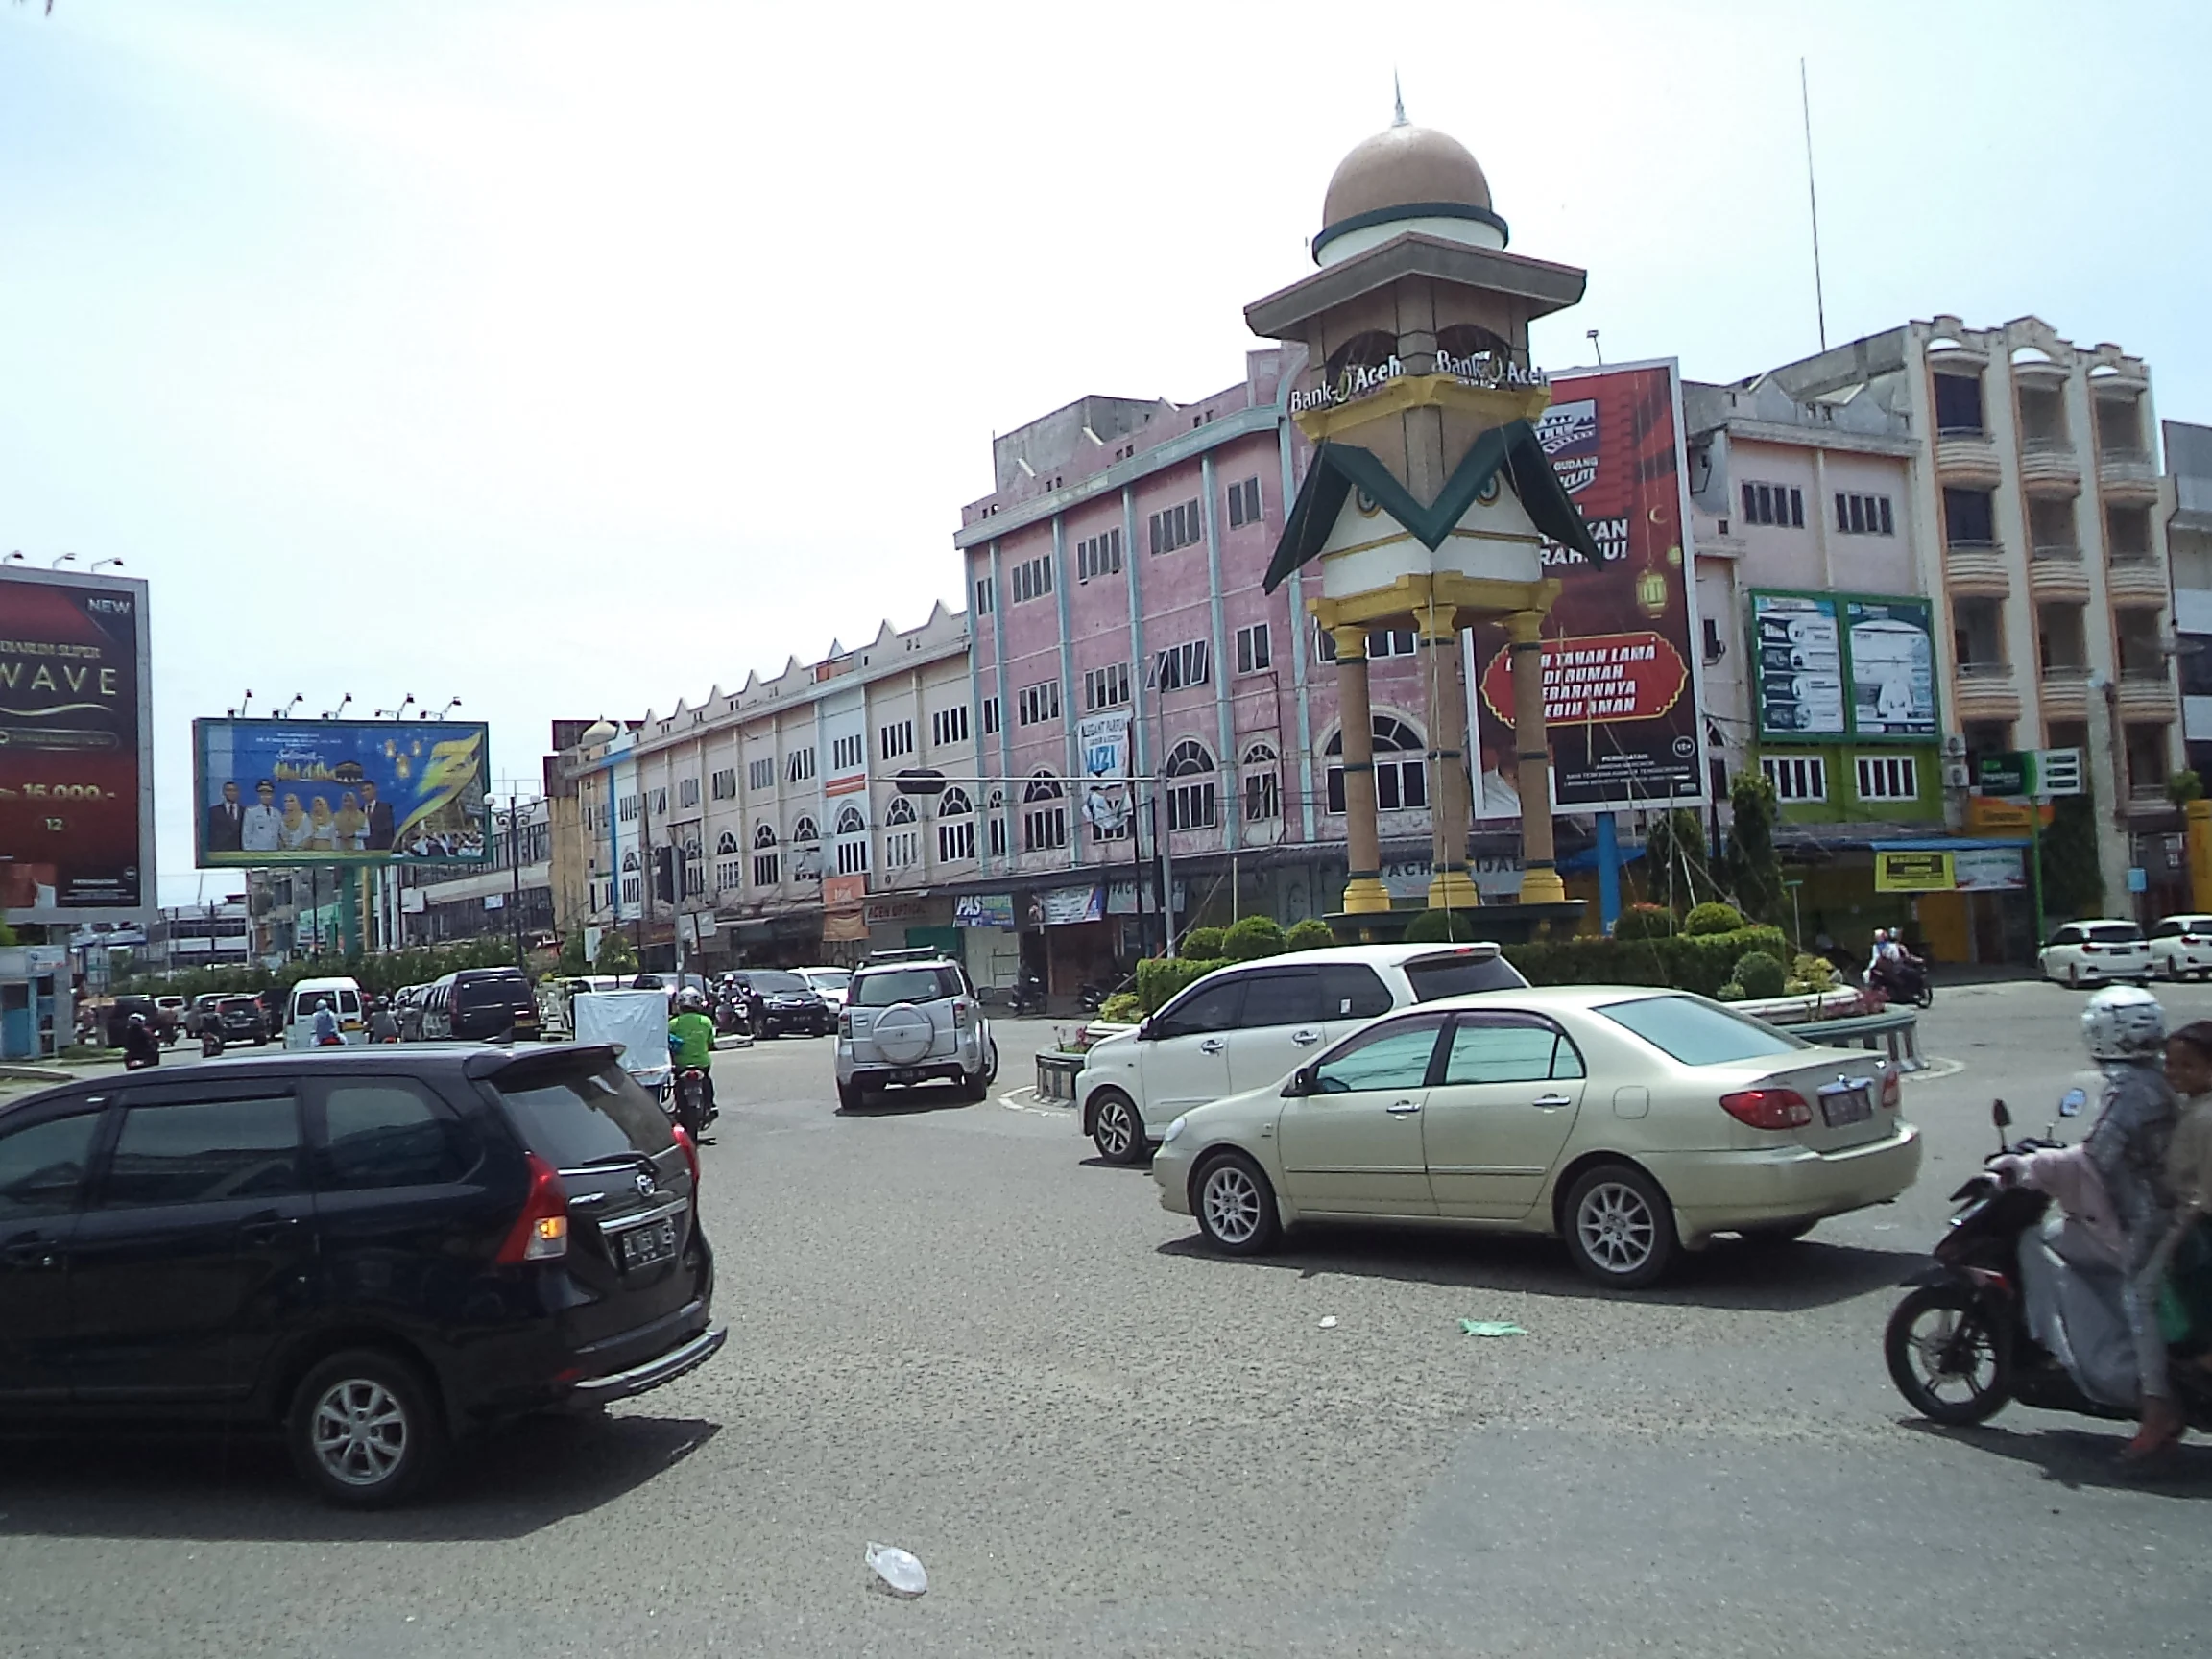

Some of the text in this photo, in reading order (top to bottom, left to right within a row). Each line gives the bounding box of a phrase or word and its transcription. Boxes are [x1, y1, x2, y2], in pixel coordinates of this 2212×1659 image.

[1435, 349, 1549, 388] Bank Aceh
[1290, 354, 1401, 413] Bank Aceh
[1552, 455, 1599, 471] GUDANG
[88, 597, 131, 613] NEW
[58, 645, 102, 659] SUPER
[1556, 648, 1607, 667] TAHAN
[1611, 644, 1656, 662] LAMA
[0, 662, 116, 695] WAVE
[1543, 664, 1624, 685] DI RUMAH
[1542, 680, 1637, 702] EBARANNYA
[1543, 701, 1583, 718] EBIH
[45, 817, 64, 831] 12
[956, 894, 982, 916] PAS
